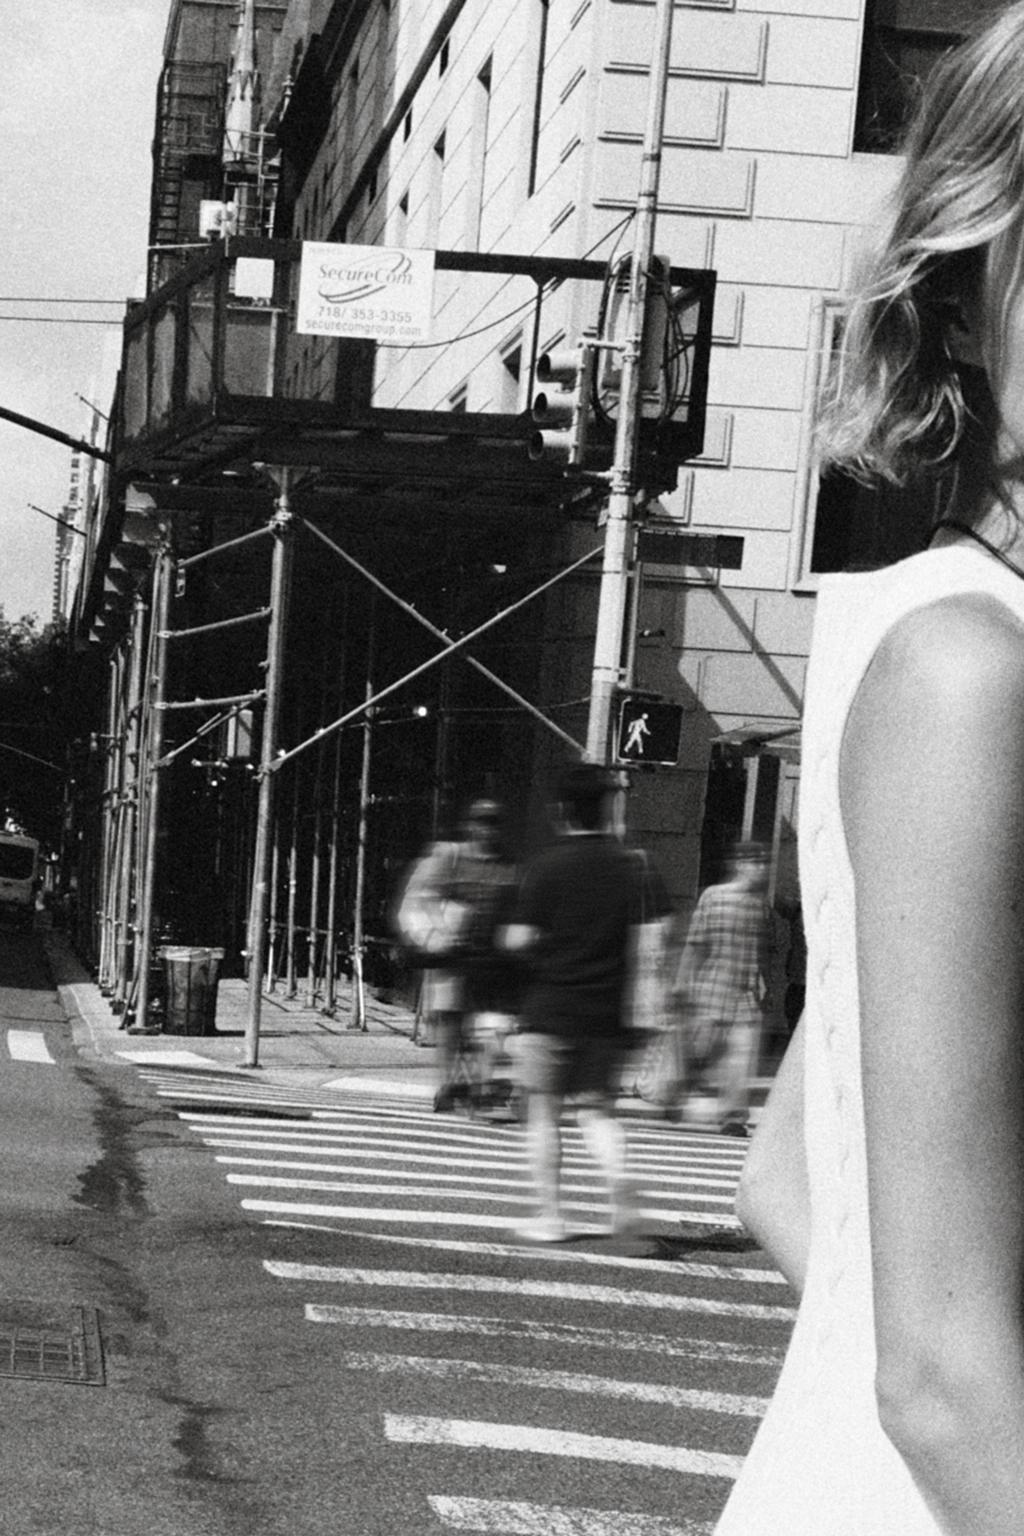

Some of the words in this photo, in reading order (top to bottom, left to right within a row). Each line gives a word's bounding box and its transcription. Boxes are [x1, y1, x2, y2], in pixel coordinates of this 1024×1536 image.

[318, 264, 413, 285] SecureCom
[351, 308, 412, 323] 353-3355
[305, 319, 421, 336] securecomgroup.com
